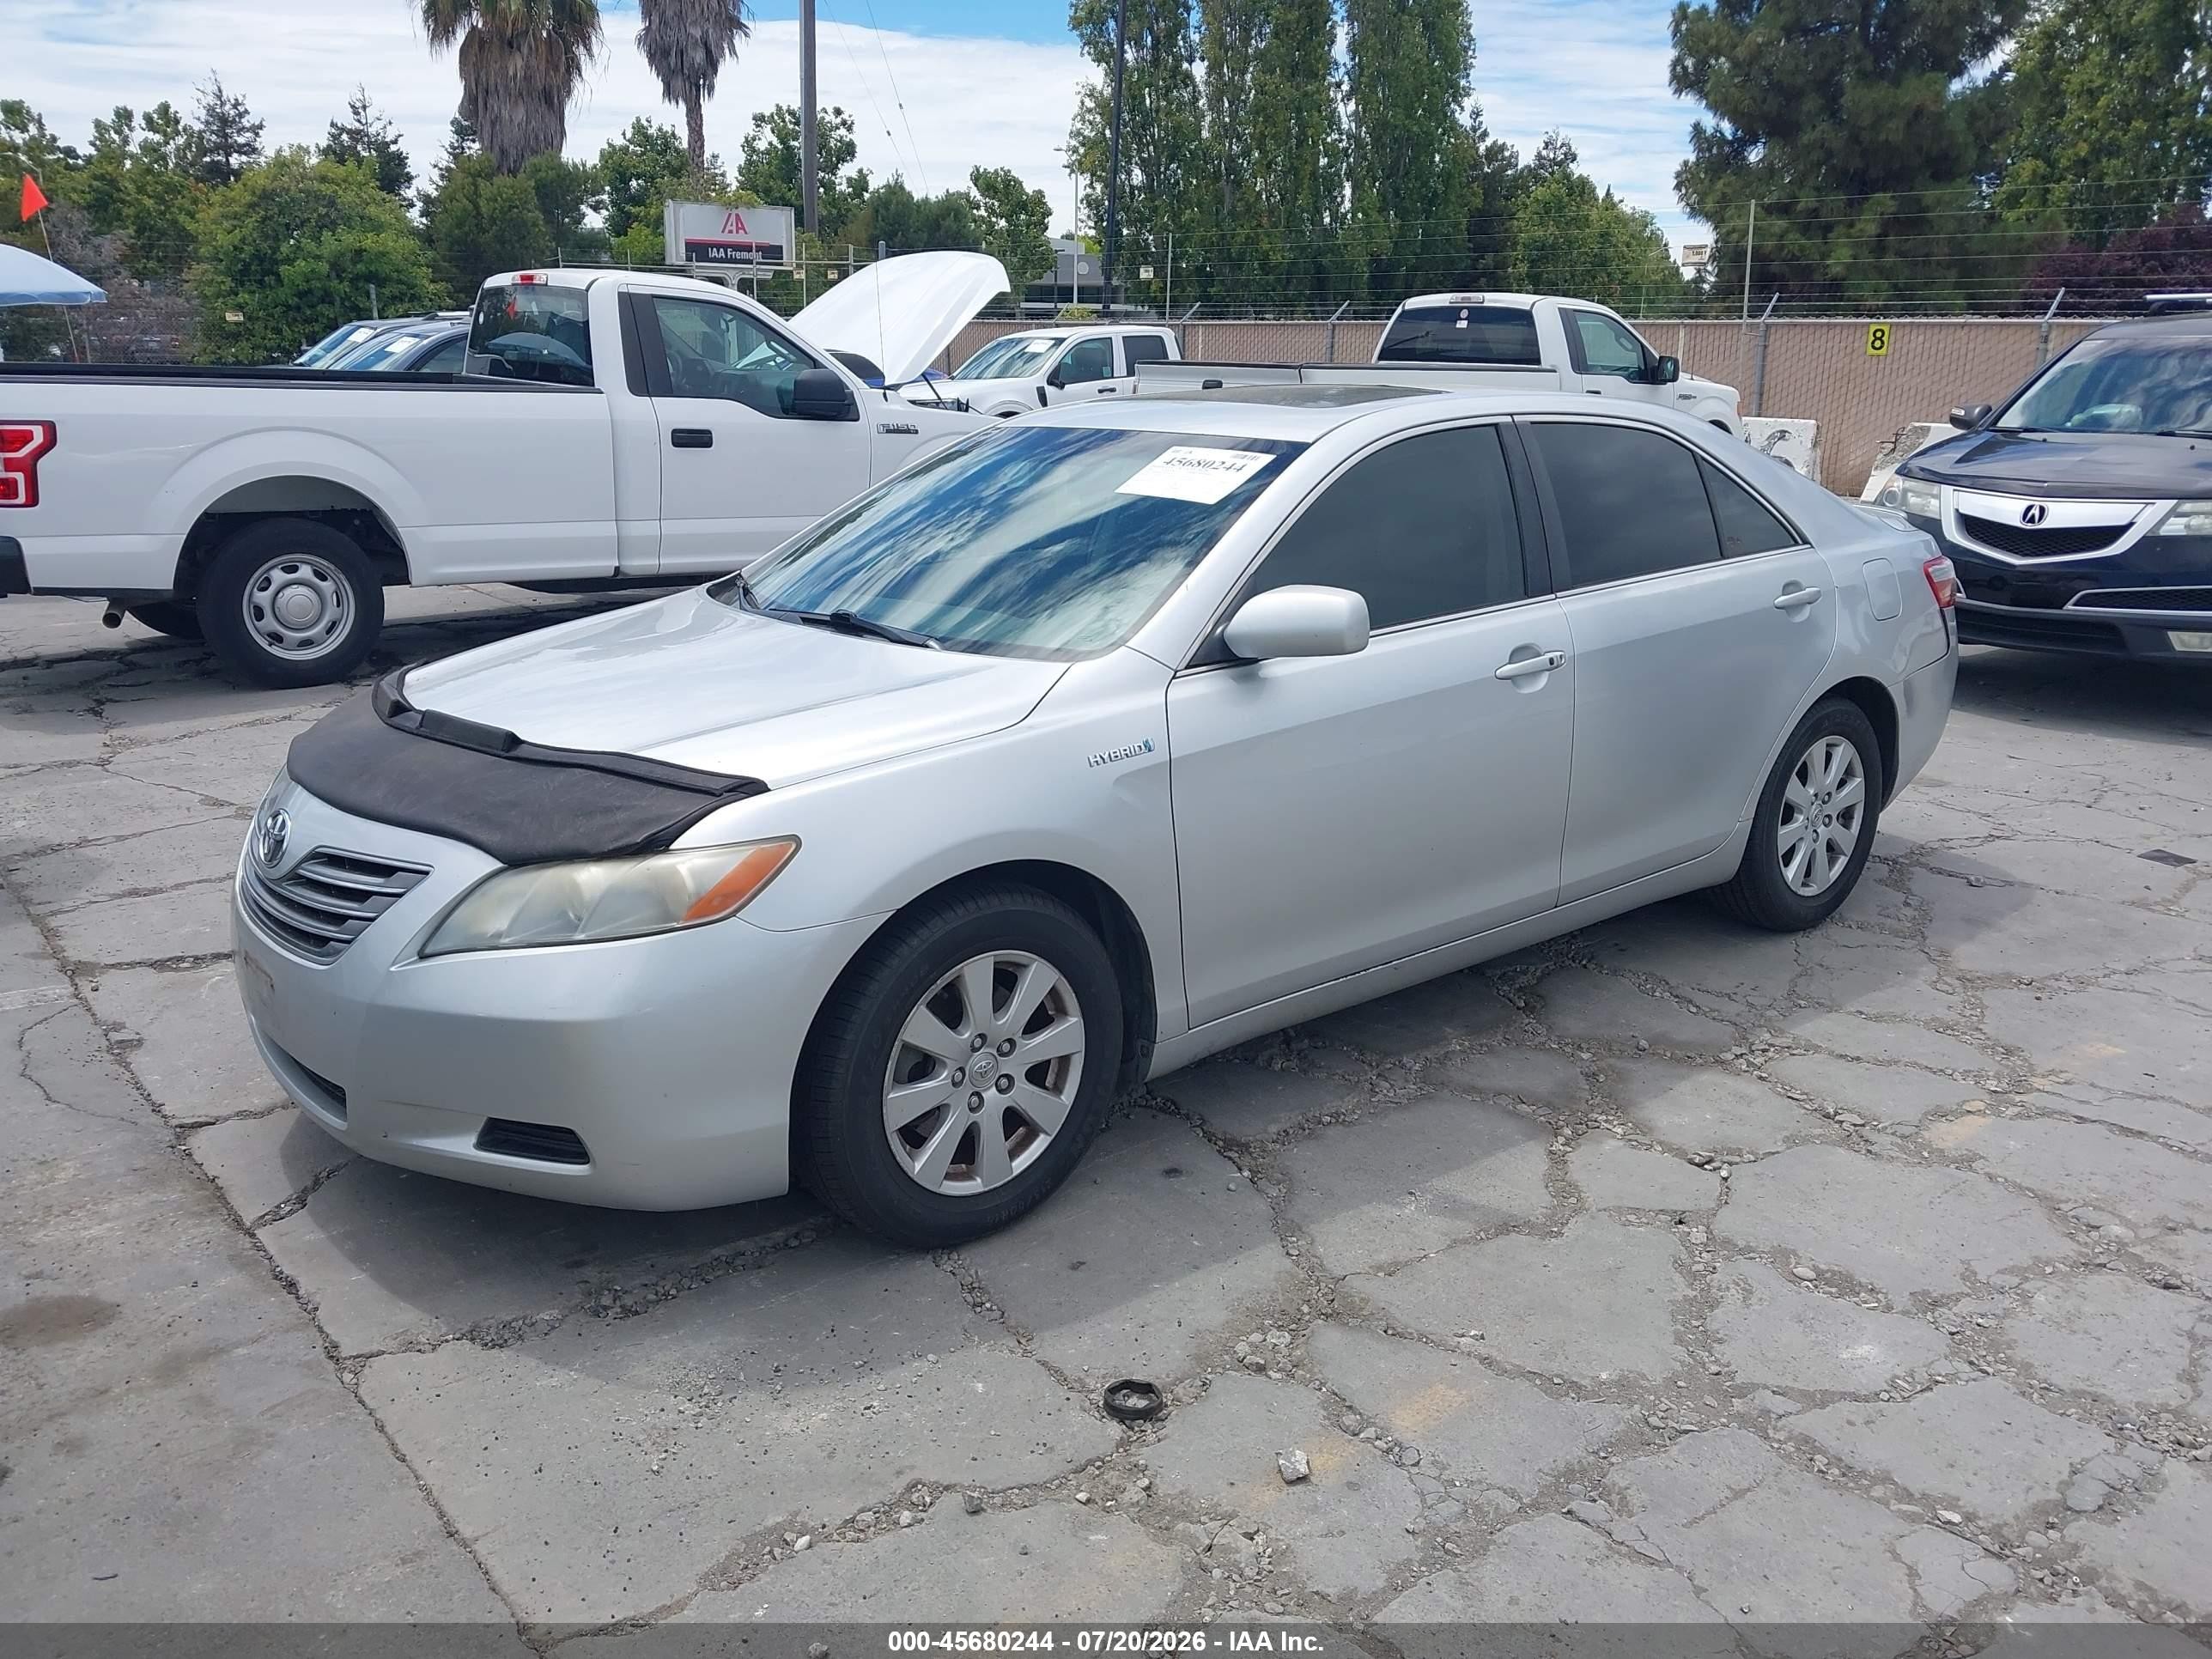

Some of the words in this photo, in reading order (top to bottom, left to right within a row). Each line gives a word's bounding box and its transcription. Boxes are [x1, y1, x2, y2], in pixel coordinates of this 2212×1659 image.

[708, 247, 726, 258] IAA
[727, 248, 763, 260] Fremont
[1871, 328, 1886, 351] 8
[1163, 457, 1249, 472] 45680244
[1087, 744, 1143, 769] HYBRID
